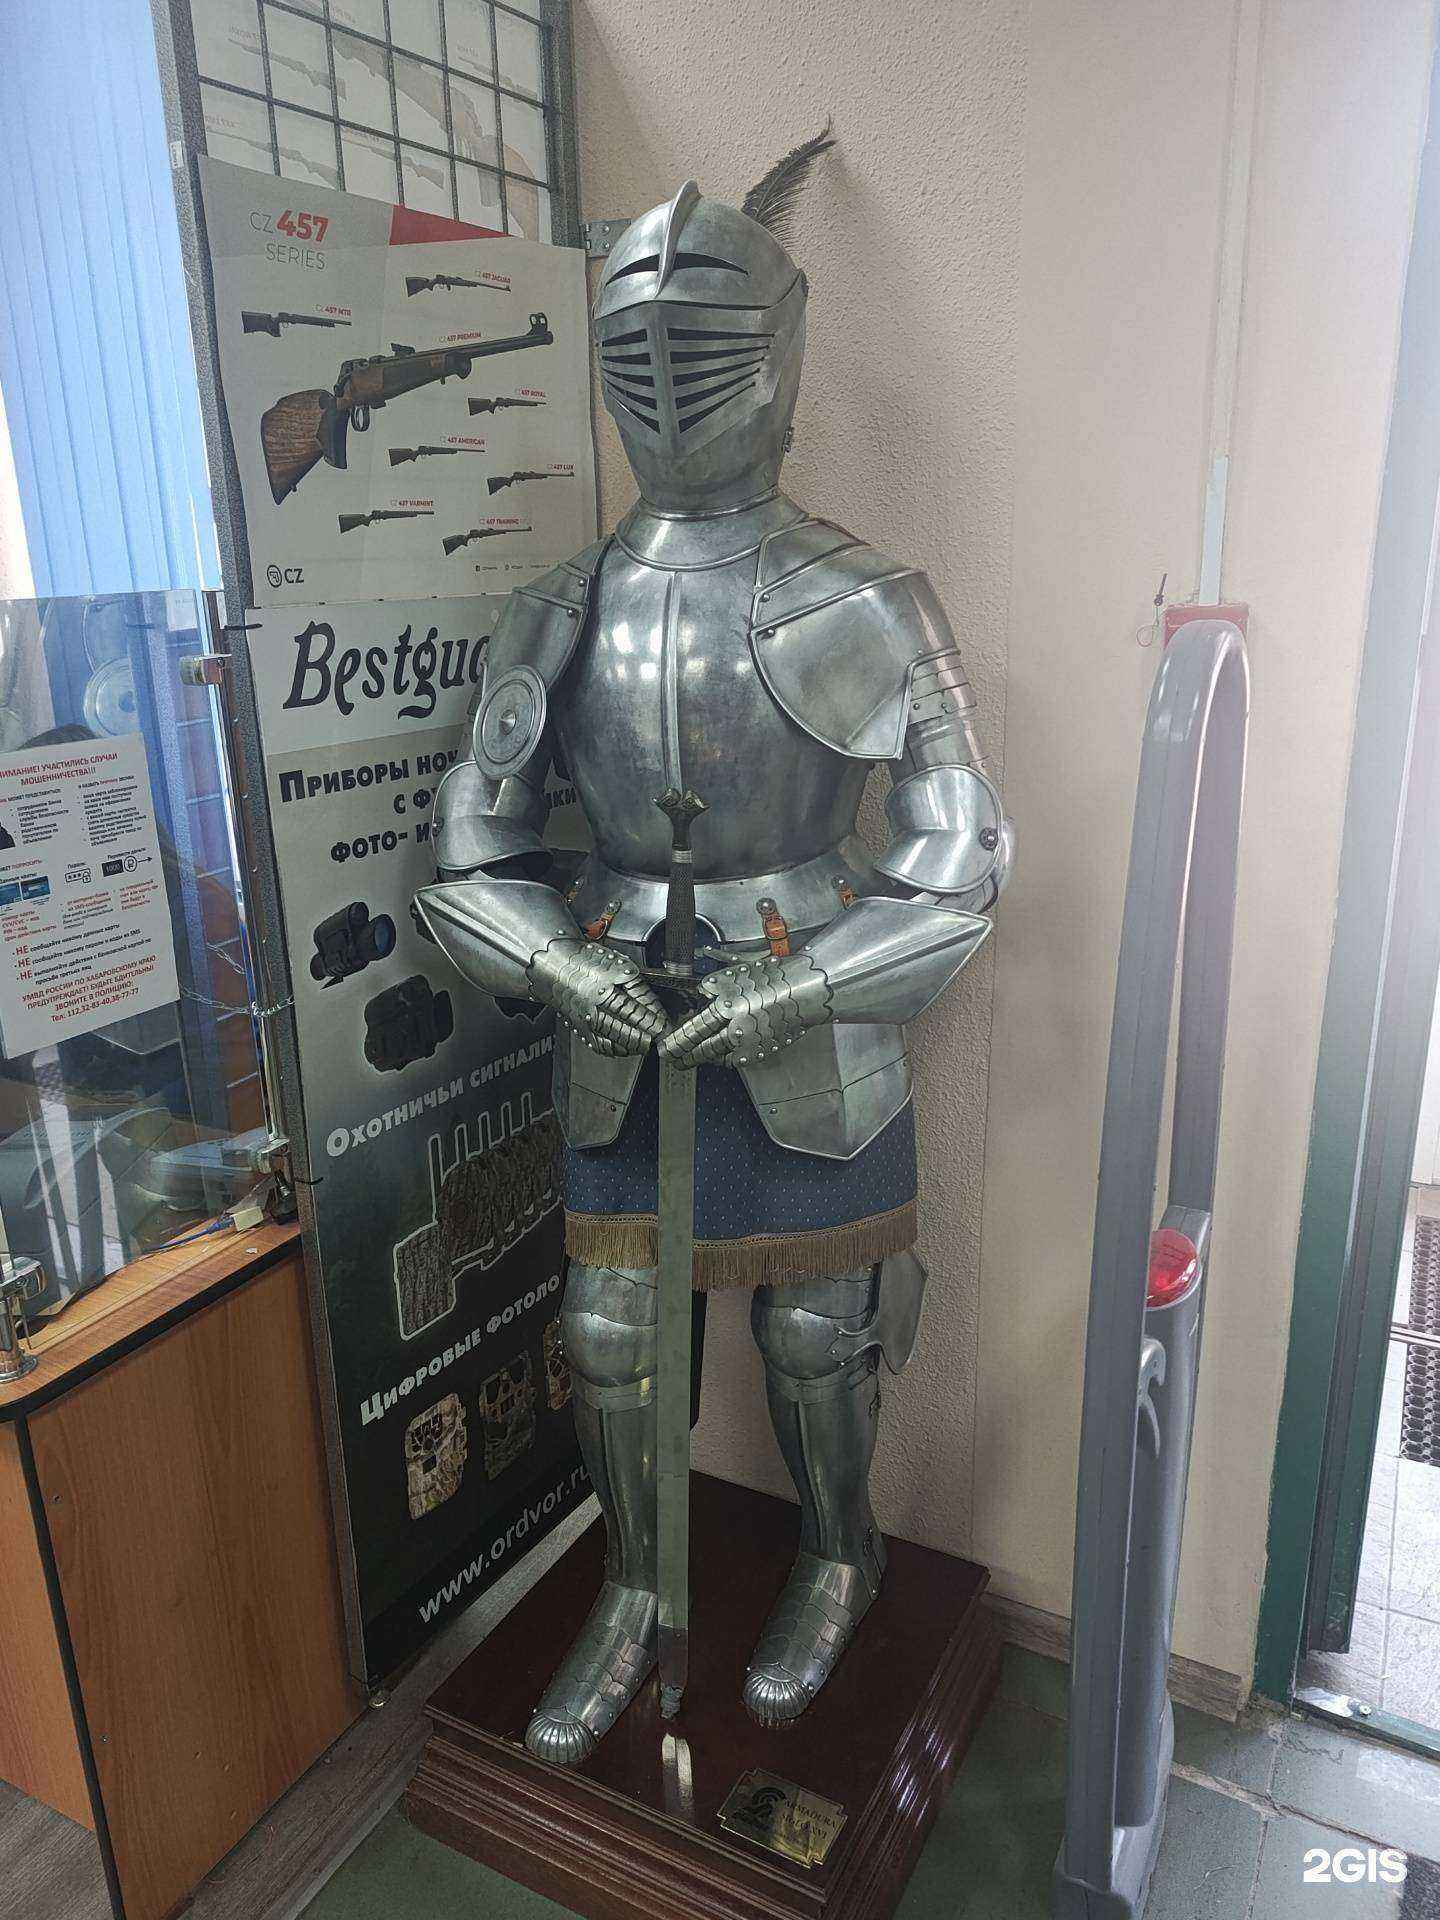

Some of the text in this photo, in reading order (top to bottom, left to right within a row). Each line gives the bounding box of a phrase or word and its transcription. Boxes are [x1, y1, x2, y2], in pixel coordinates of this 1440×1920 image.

[250, 209, 329, 241] CZ 457
[266, 243, 325, 270] SERIES
[285, 568, 304, 583] CZ
[42, 758, 89, 772] УЧАСТИЛИСЬ
[90, 753, 118, 764] СЛУЧАИ
[15, 945, 29, 956] НЕ
[17, 957, 31, 968] НЕ
[20, 970, 33, 981] НЕ
[45, 982, 73, 995] РОССИИ
[86, 960, 138, 982] ХАБАРОВСКОМУ
[138, 954, 156, 966] КРАЮ
[55, 995, 87, 1011] ЗВОНИТЕ
